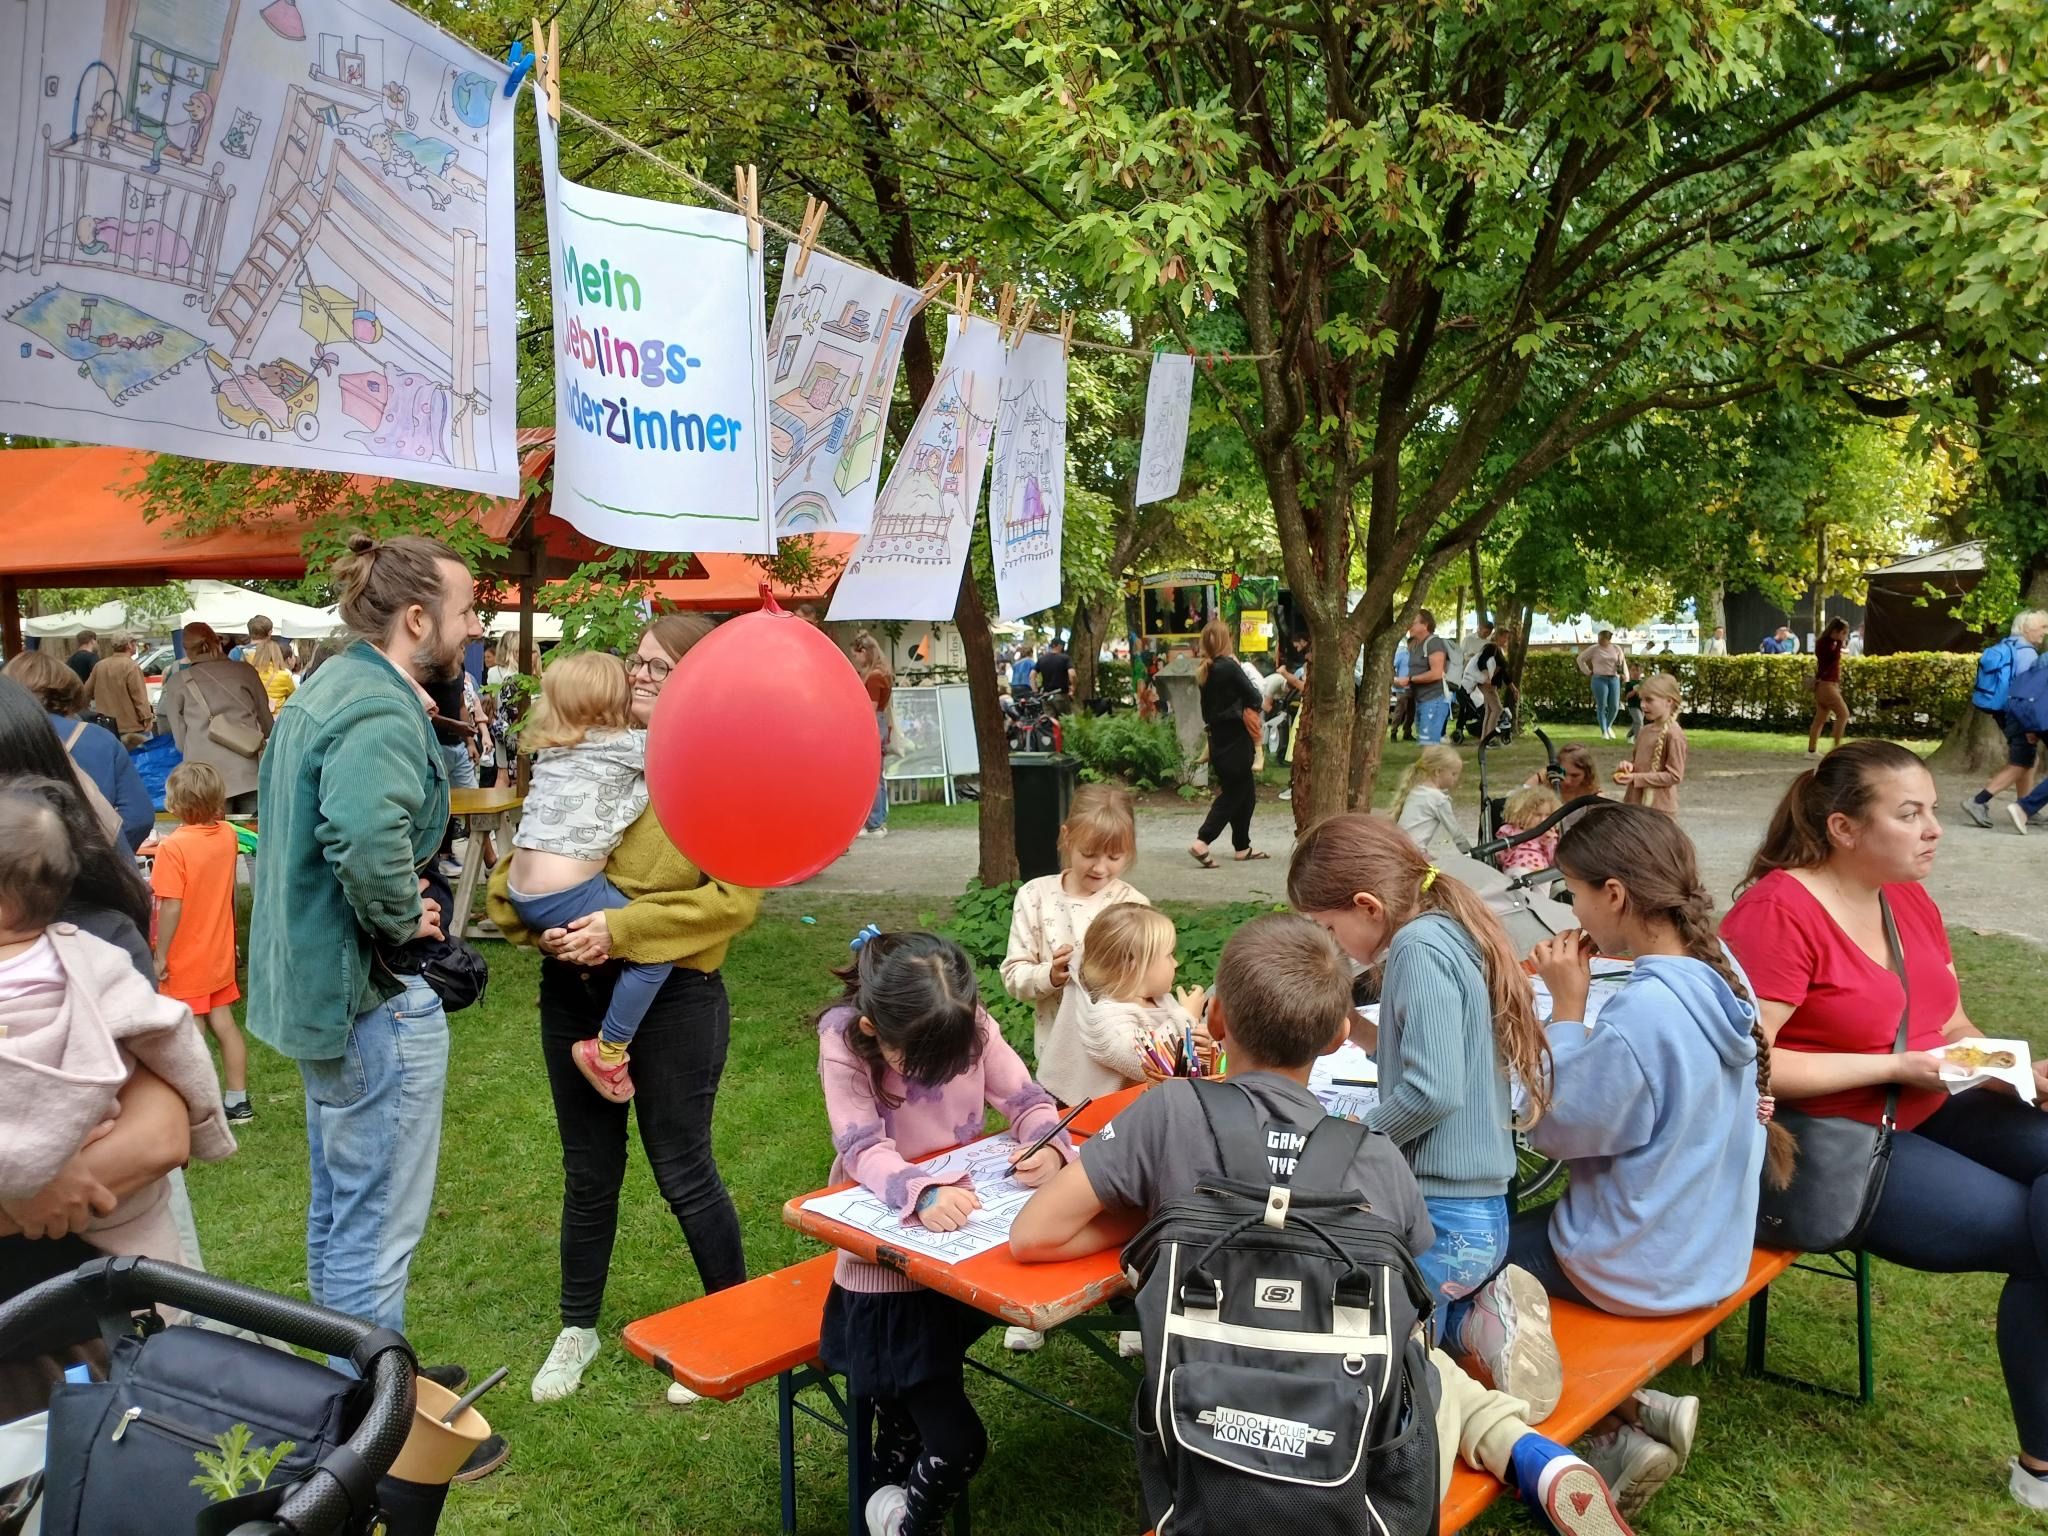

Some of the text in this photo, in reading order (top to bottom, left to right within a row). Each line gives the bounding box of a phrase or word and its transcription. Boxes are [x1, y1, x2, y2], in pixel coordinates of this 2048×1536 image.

[561, 237, 641, 312] Mein
[566, 377, 742, 452] nderzimmer
[1267, 1131, 1307, 1152] GAM
[1267, 1155, 1298, 1175] OVE
[1215, 1422, 1305, 1455] KONSTANZ
[1216, 1411, 1258, 1429] JUDO
[1279, 1424, 1306, 1439] CLUB
